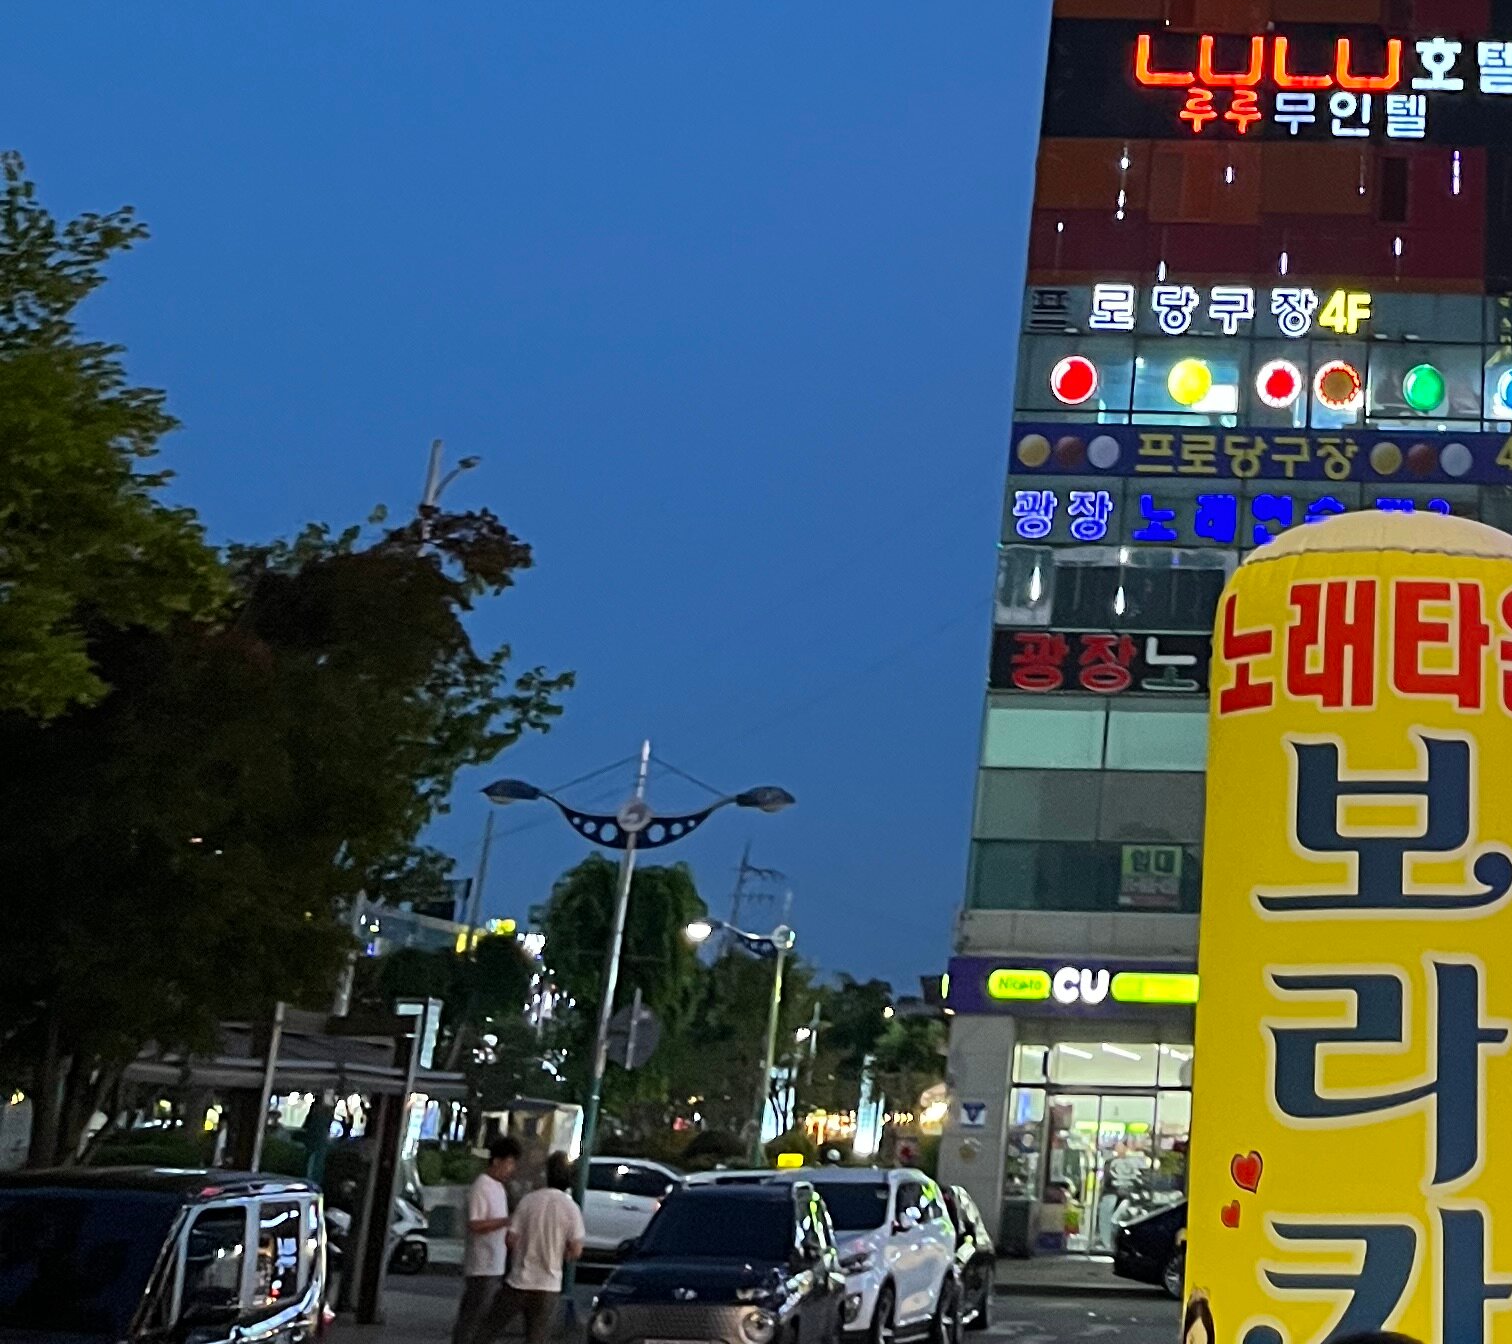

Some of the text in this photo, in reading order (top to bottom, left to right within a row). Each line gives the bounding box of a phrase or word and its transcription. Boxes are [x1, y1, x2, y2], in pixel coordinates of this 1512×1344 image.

[1318, 289, 1372, 334] 4F
[1134, 432, 1358, 481] 프로당구장
[1053, 966, 1111, 1005] CU
